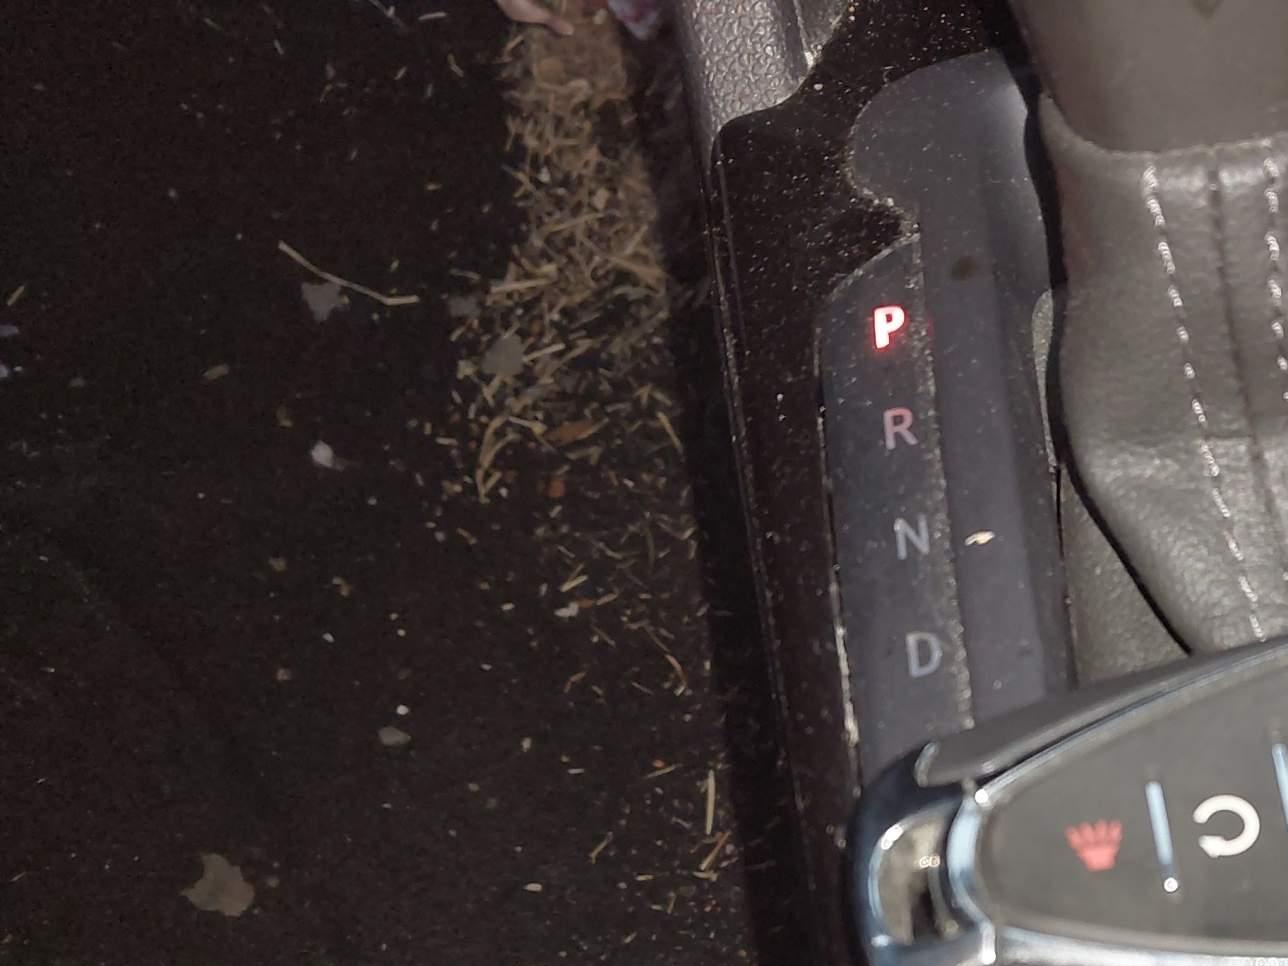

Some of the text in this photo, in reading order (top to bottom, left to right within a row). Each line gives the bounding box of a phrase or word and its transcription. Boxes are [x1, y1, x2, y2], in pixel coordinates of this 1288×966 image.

[872, 304, 905, 350] P
[882, 407, 918, 450] R
[893, 514, 930, 560] N
[905, 631, 942, 678] D
